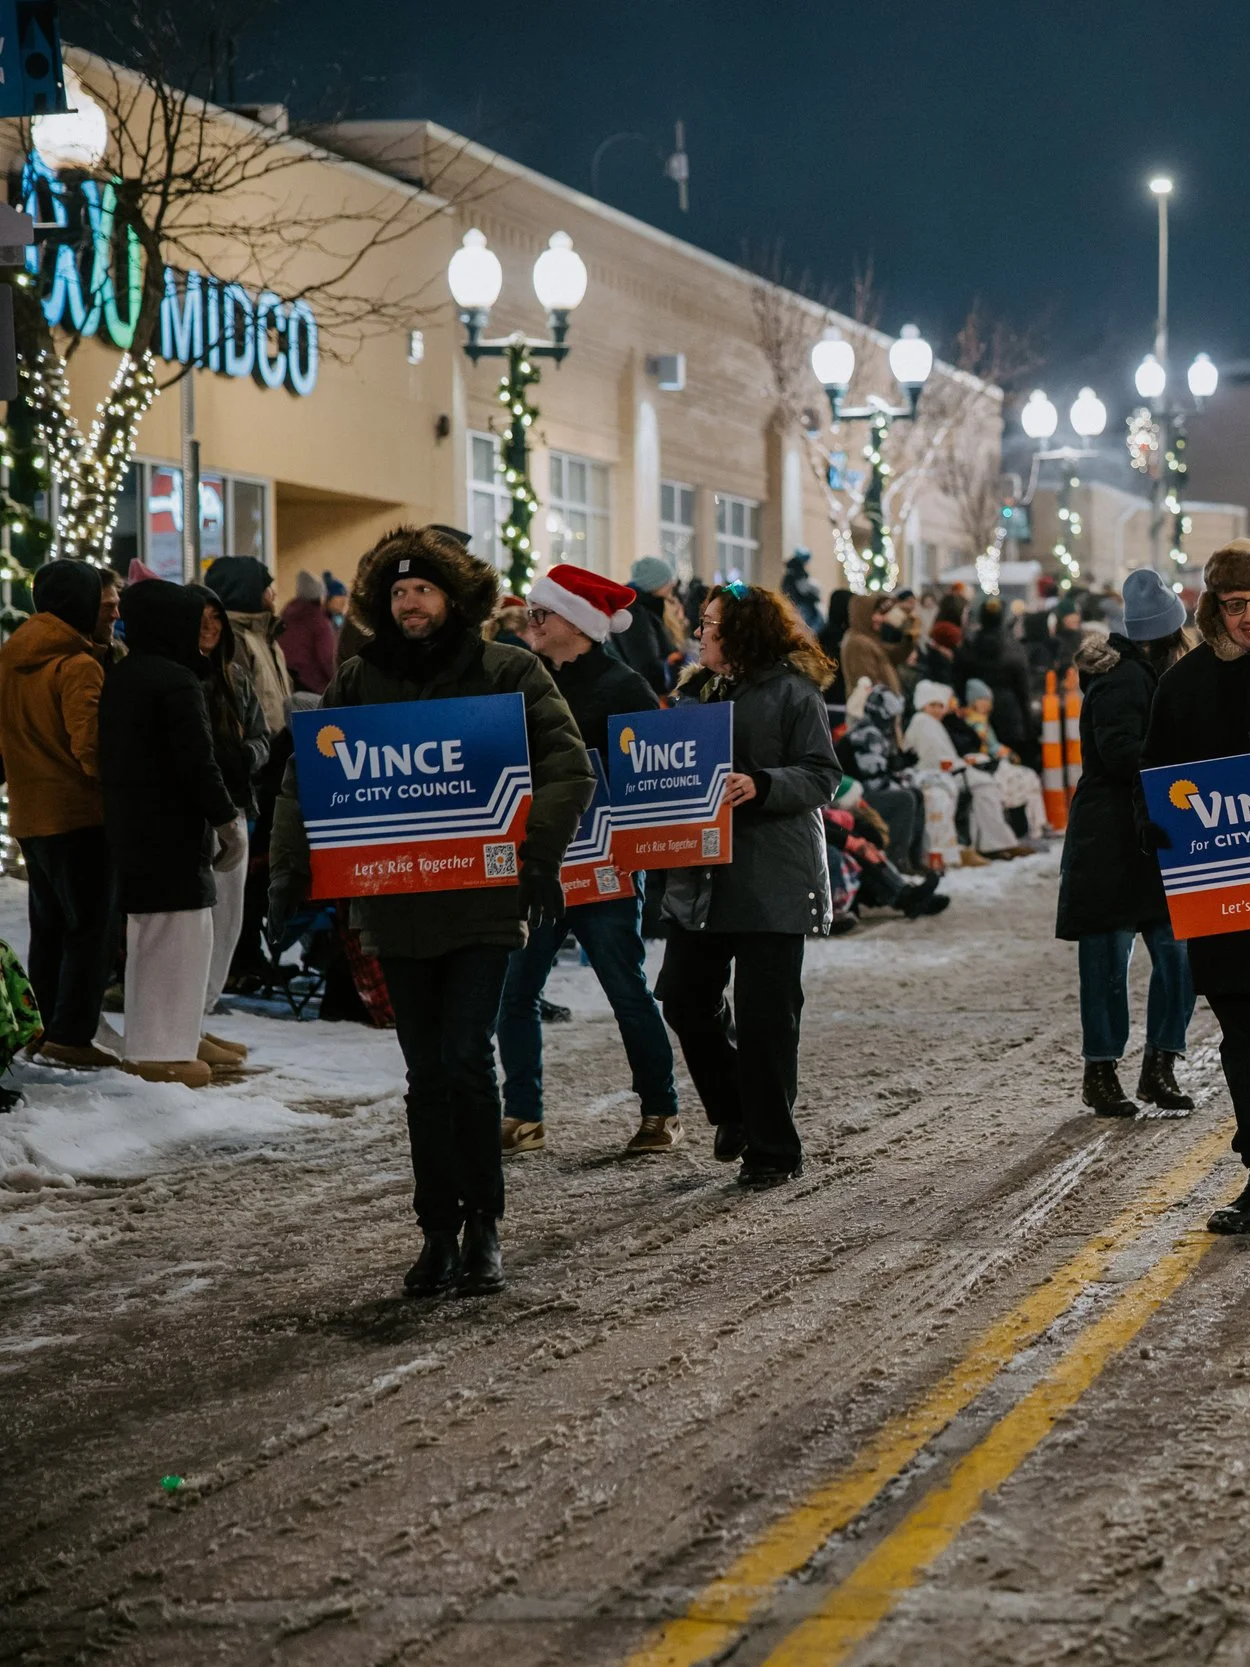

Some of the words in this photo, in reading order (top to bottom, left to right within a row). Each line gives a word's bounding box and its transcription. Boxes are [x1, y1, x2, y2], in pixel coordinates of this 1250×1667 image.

[160, 266, 318, 397] MIDCO
[334, 739, 464, 780] VINCE
[629, 739, 697, 774] VINCE
[330, 791, 350, 807] for
[355, 786, 393, 802] CITY
[397, 780, 476, 799] COUNCIL
[625, 782, 636, 795] for
[638, 778, 658, 792] CITY
[659, 774, 702, 790] COUNCIL
[635, 841, 651, 854] Let's
[652, 840, 666, 851] Rise
[668, 838, 698, 852] Together
[1189, 839, 1210, 854] for
[355, 860, 384, 876] Let's
[387, 859, 414, 874] Rise
[417, 855, 475, 874] Together
[562, 878, 591, 892] gether
[1221, 899, 1250, 915] Let's
